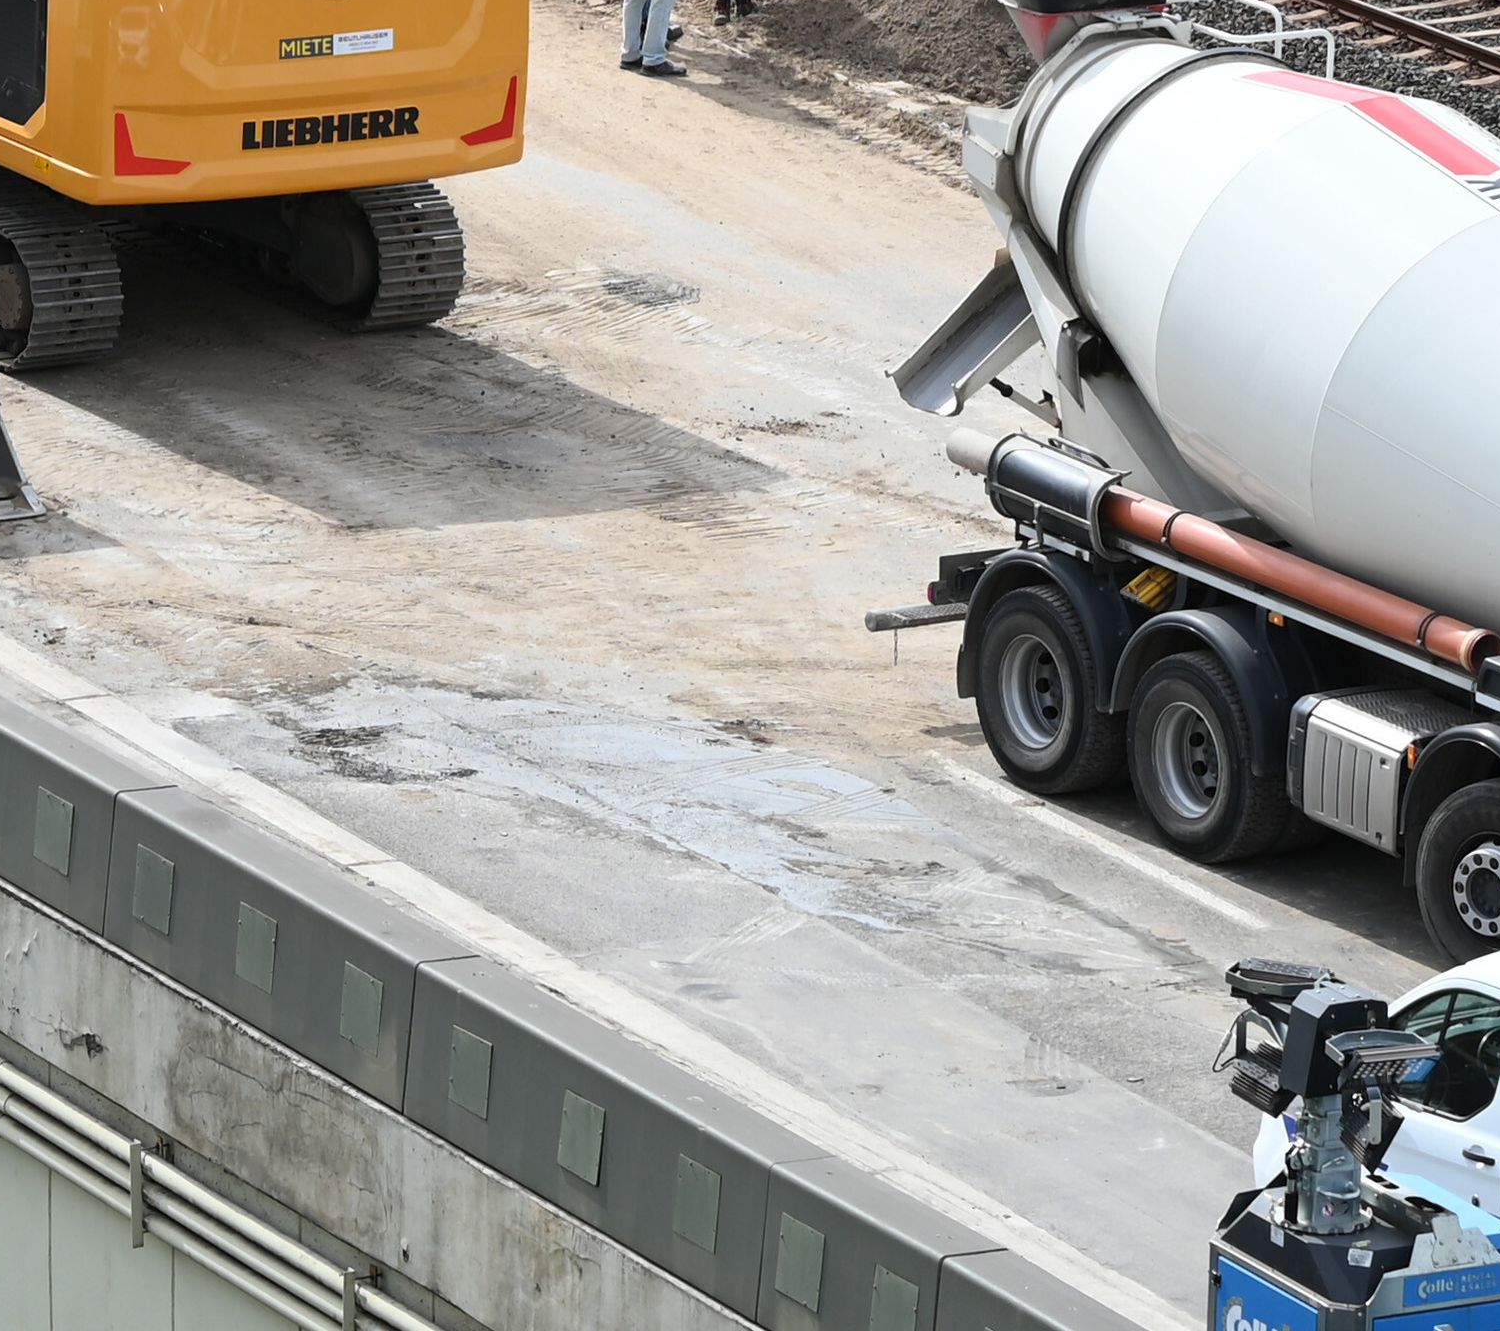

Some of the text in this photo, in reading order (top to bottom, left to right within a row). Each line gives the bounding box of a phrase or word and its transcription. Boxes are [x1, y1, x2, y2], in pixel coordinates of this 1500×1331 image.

[281, 35, 333, 57] MIETE
[241, 106, 420, 150] LIEBHERR
[1461, 1272, 1496, 1284] RENTAL
